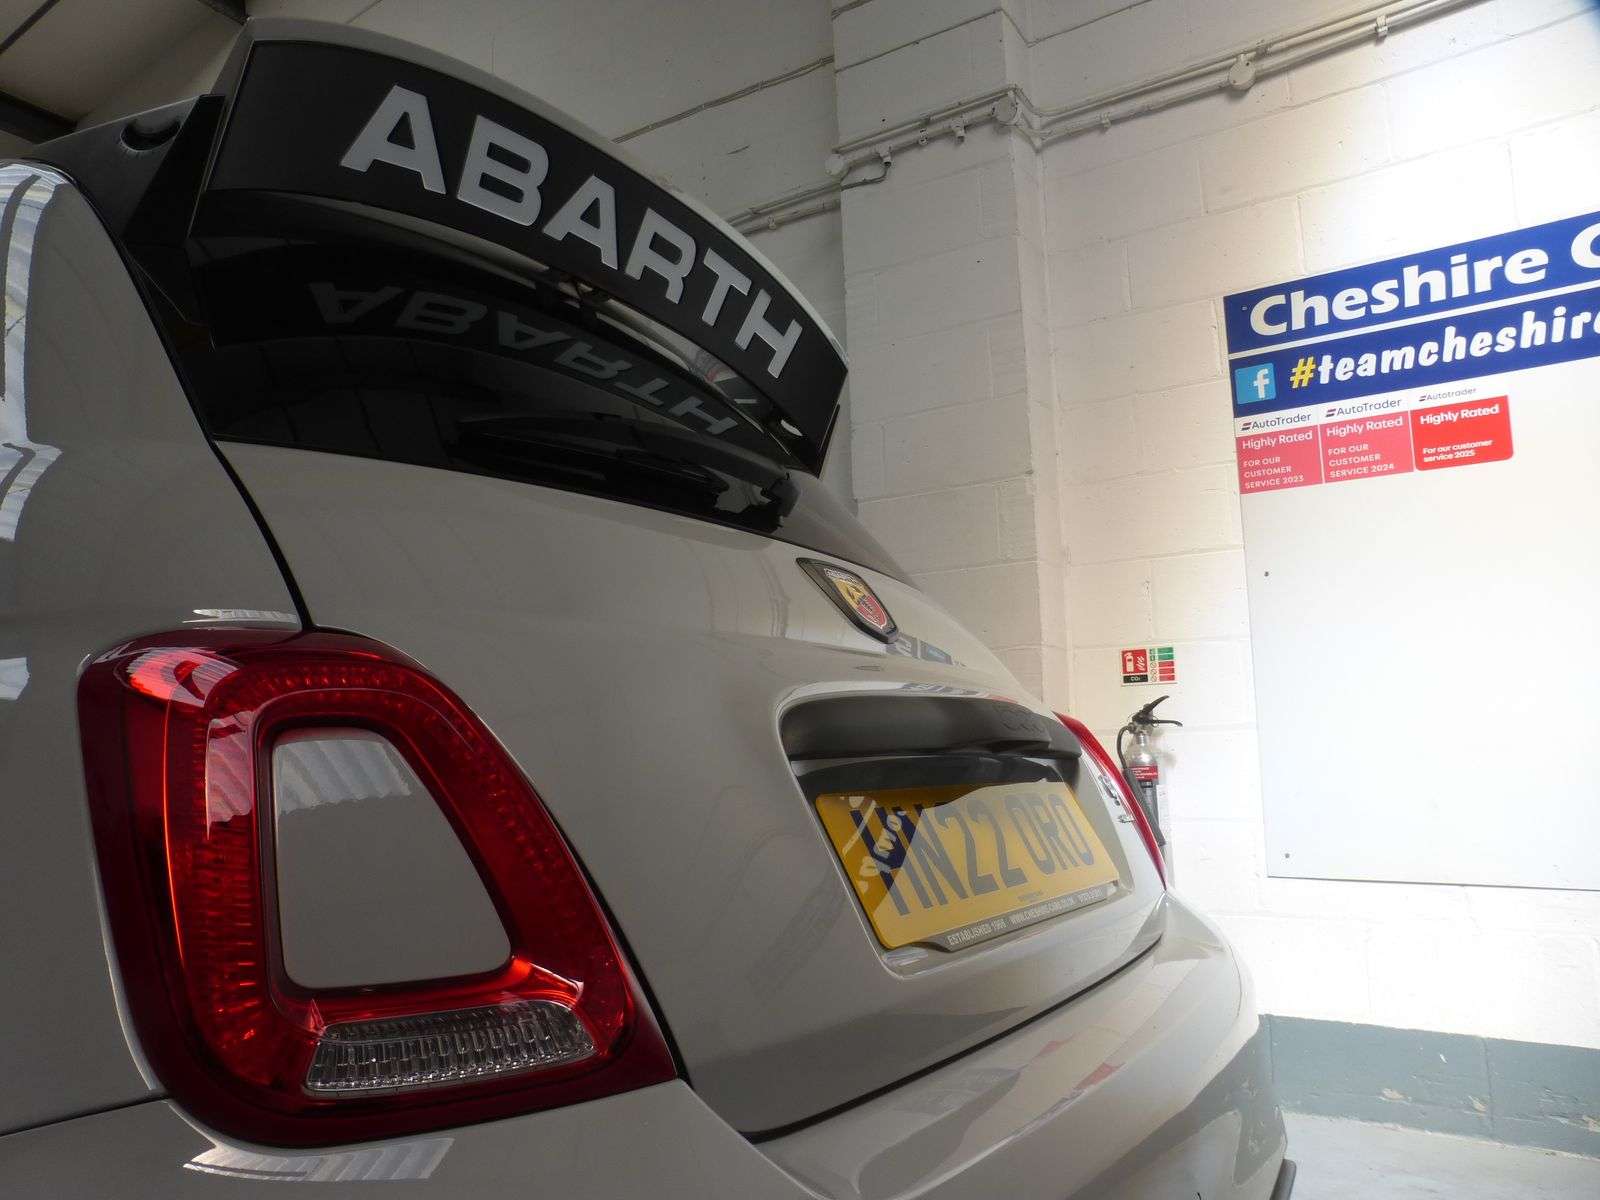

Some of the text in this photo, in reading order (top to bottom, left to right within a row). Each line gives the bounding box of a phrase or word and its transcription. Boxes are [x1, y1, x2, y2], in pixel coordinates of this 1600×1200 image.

[340, 85, 802, 379] ABARTH
[1250, 248, 1549, 336] Cheshire
[1337, 399, 1402, 416] AutoTrader
[1420, 403, 1500, 425] Highly Rated
[1251, 412, 1312, 430] AutoTrader
[1326, 416, 1403, 437] Highly Rated
[1242, 430, 1313, 450] Highly Rated
[1422, 439, 1493, 455] For our customer
[1328, 443, 1369, 456] FOR OUR
[1243, 456, 1281, 468] FOR OUR
[1329, 453, 1381, 467] CUSTOMER
[1244, 465, 1292, 479] CUSTOMER
[1330, 463, 1394, 478] SERVICE 2024
[1245, 474, 1304, 489] SERVICE 2023
